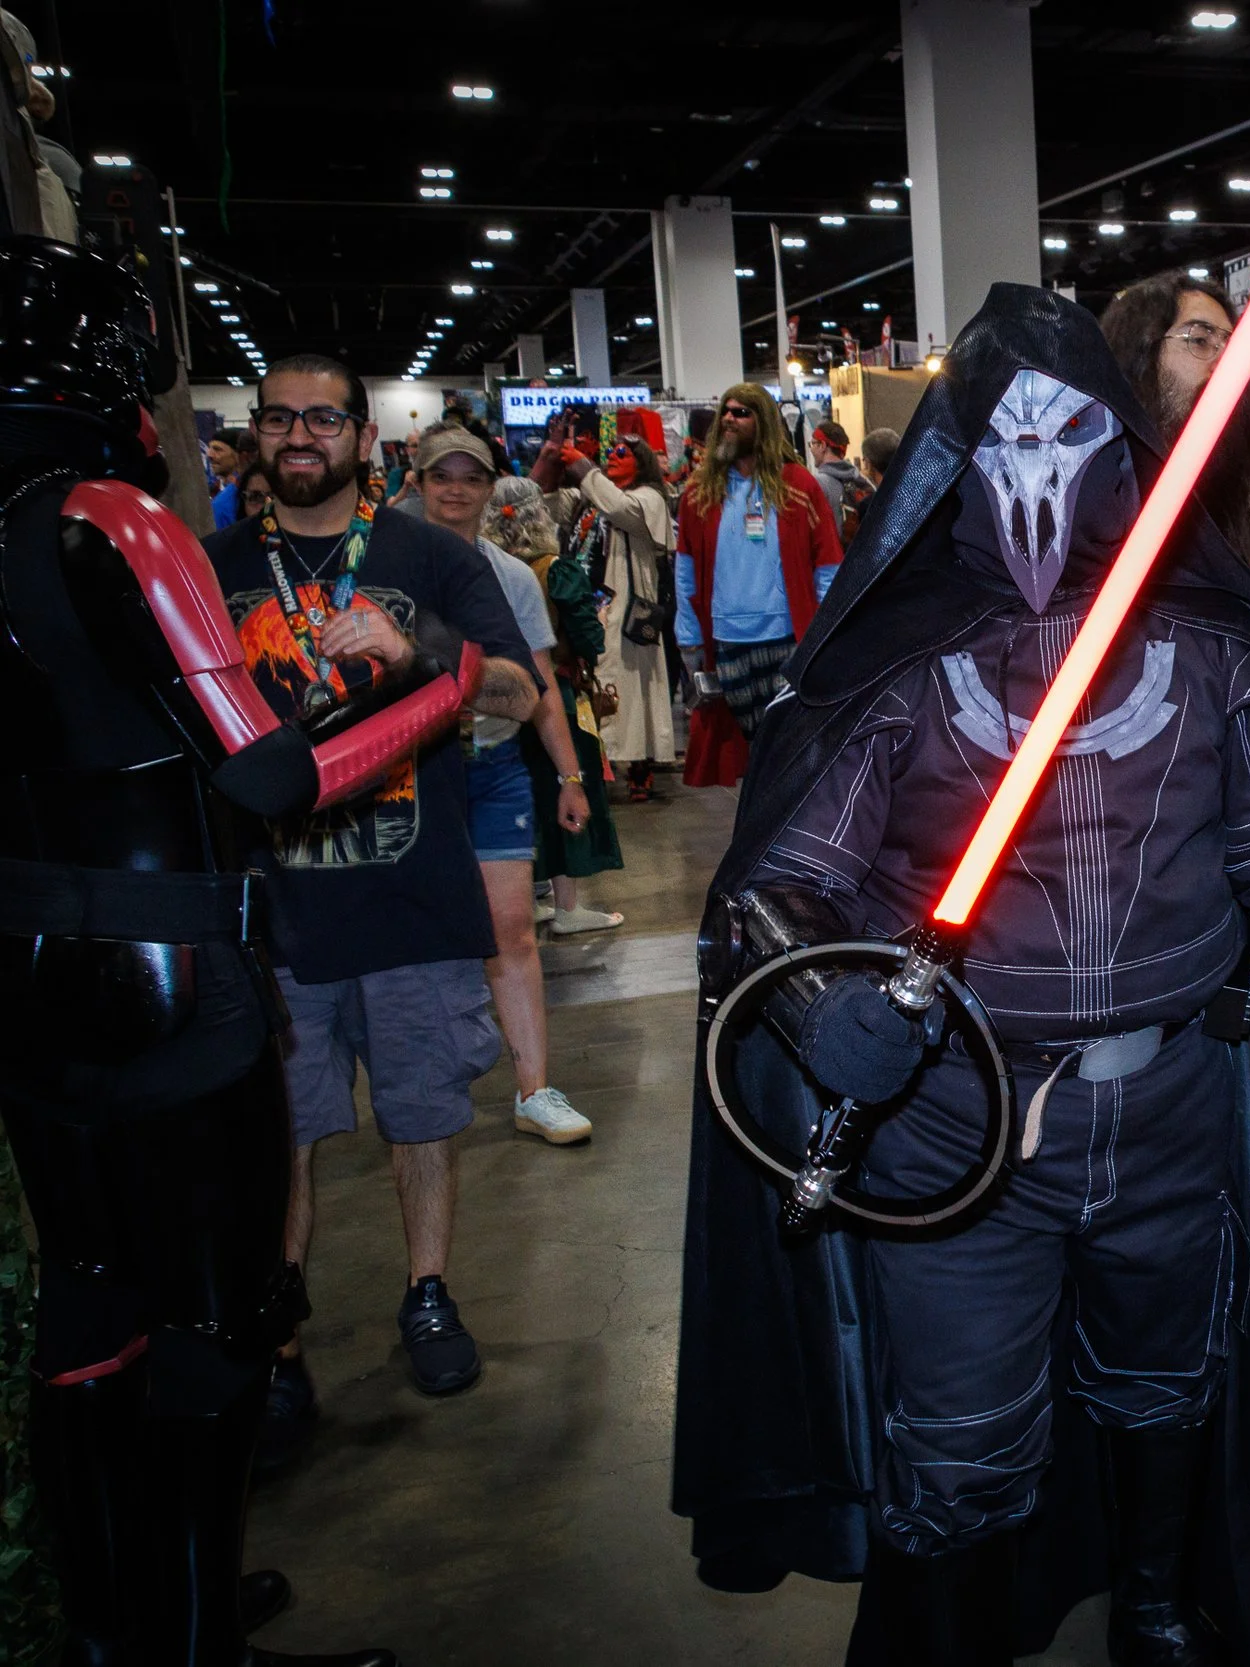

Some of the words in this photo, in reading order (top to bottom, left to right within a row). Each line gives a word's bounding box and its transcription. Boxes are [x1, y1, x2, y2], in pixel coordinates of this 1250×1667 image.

[510, 395, 584, 406] DRAGON
[591, 394, 647, 404] ROAST
[267, 550, 297, 612] HALLOWEEN
